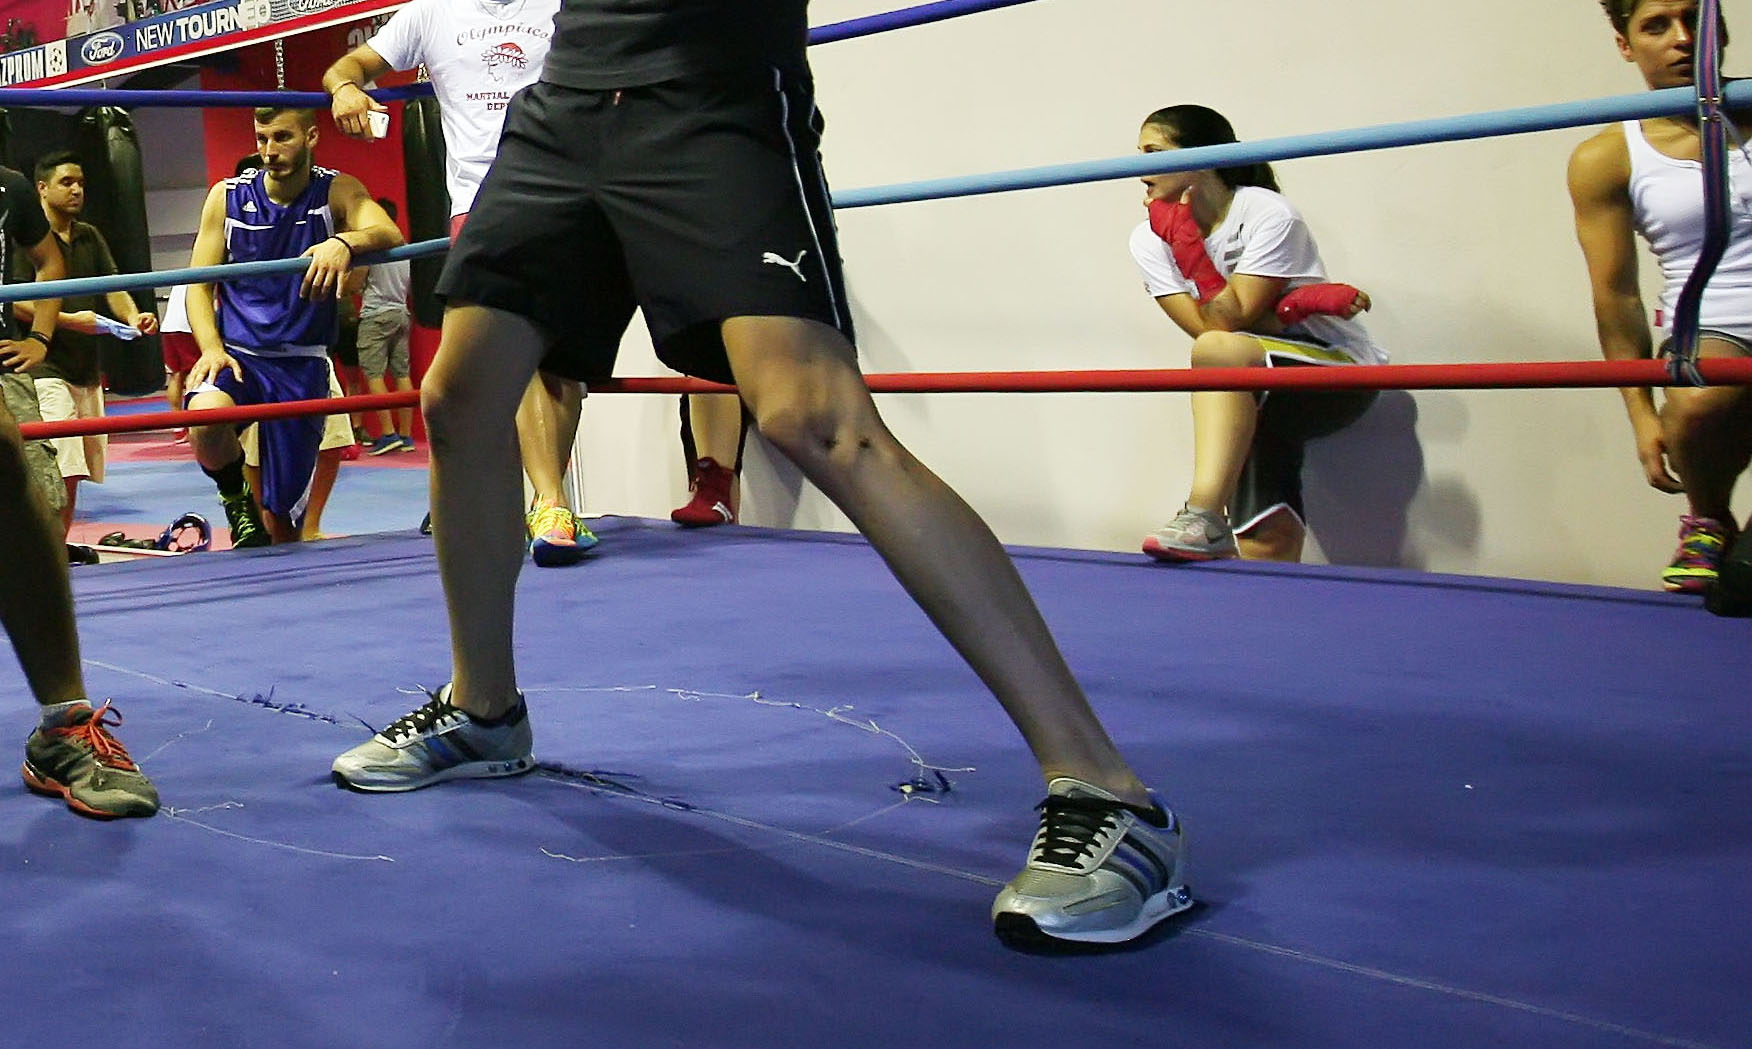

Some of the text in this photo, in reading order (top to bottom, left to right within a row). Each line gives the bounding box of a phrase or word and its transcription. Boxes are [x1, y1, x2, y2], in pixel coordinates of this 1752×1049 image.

[135, 19, 176, 53] NEW
[456, 21, 551, 47] Olympiaco
[86, 37, 120, 64] Ford
[466, 91, 510, 101] MARTIAL
